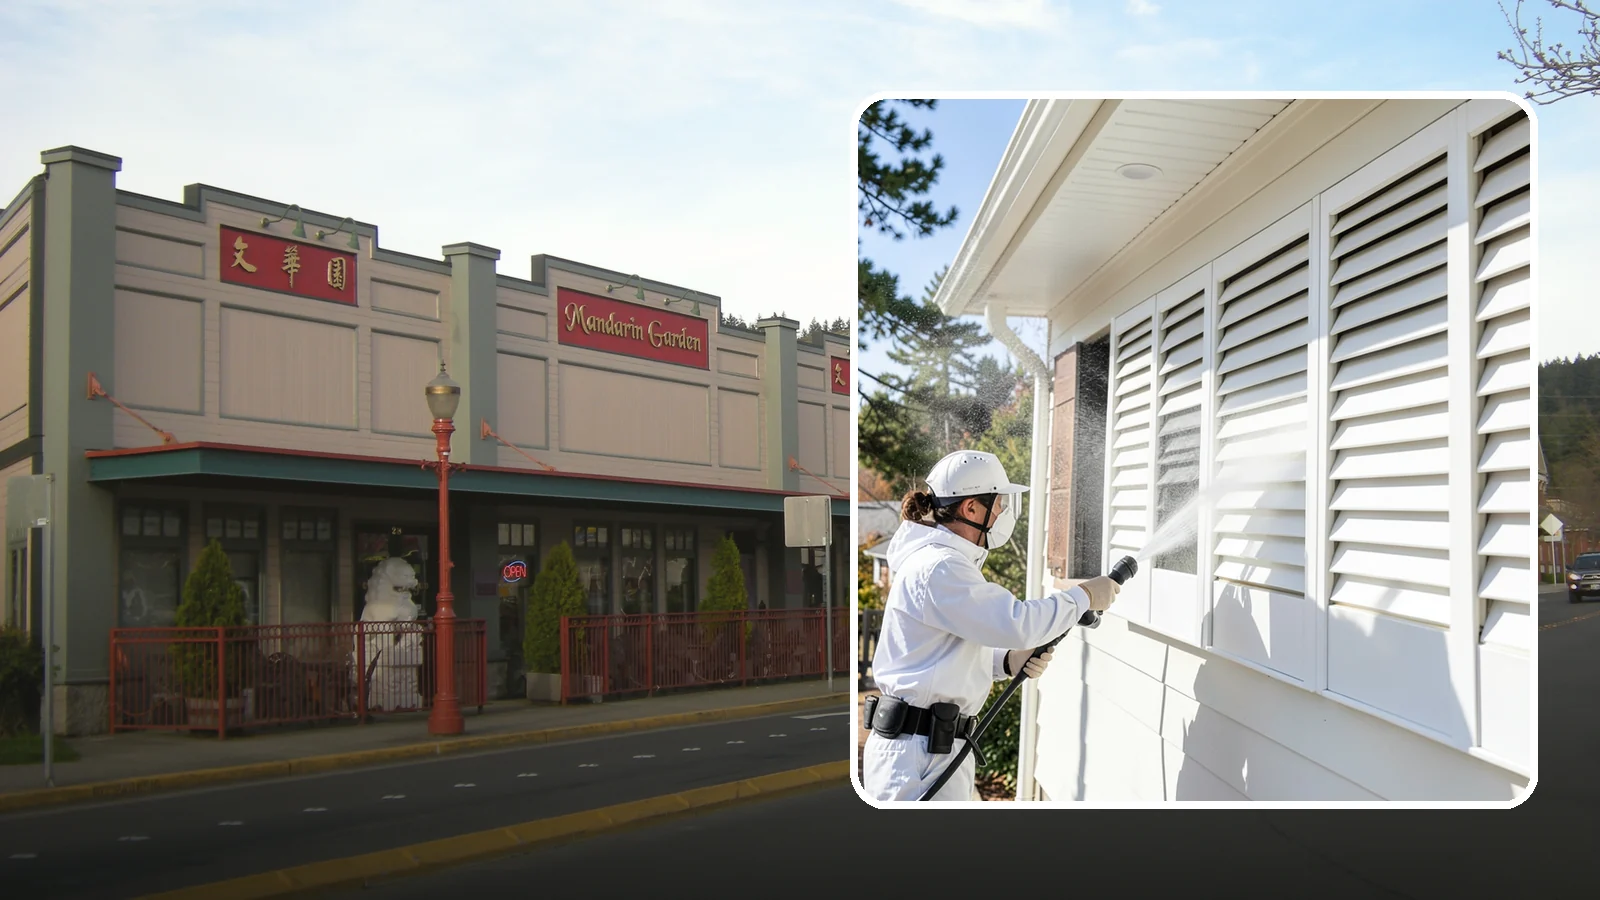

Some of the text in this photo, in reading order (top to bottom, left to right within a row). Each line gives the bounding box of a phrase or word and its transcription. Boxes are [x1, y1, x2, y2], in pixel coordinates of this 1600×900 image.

[231, 235, 346, 290] 文華園
[564, 302, 702, 352] Mandarin Garden
[503, 565, 527, 578] OPEN
